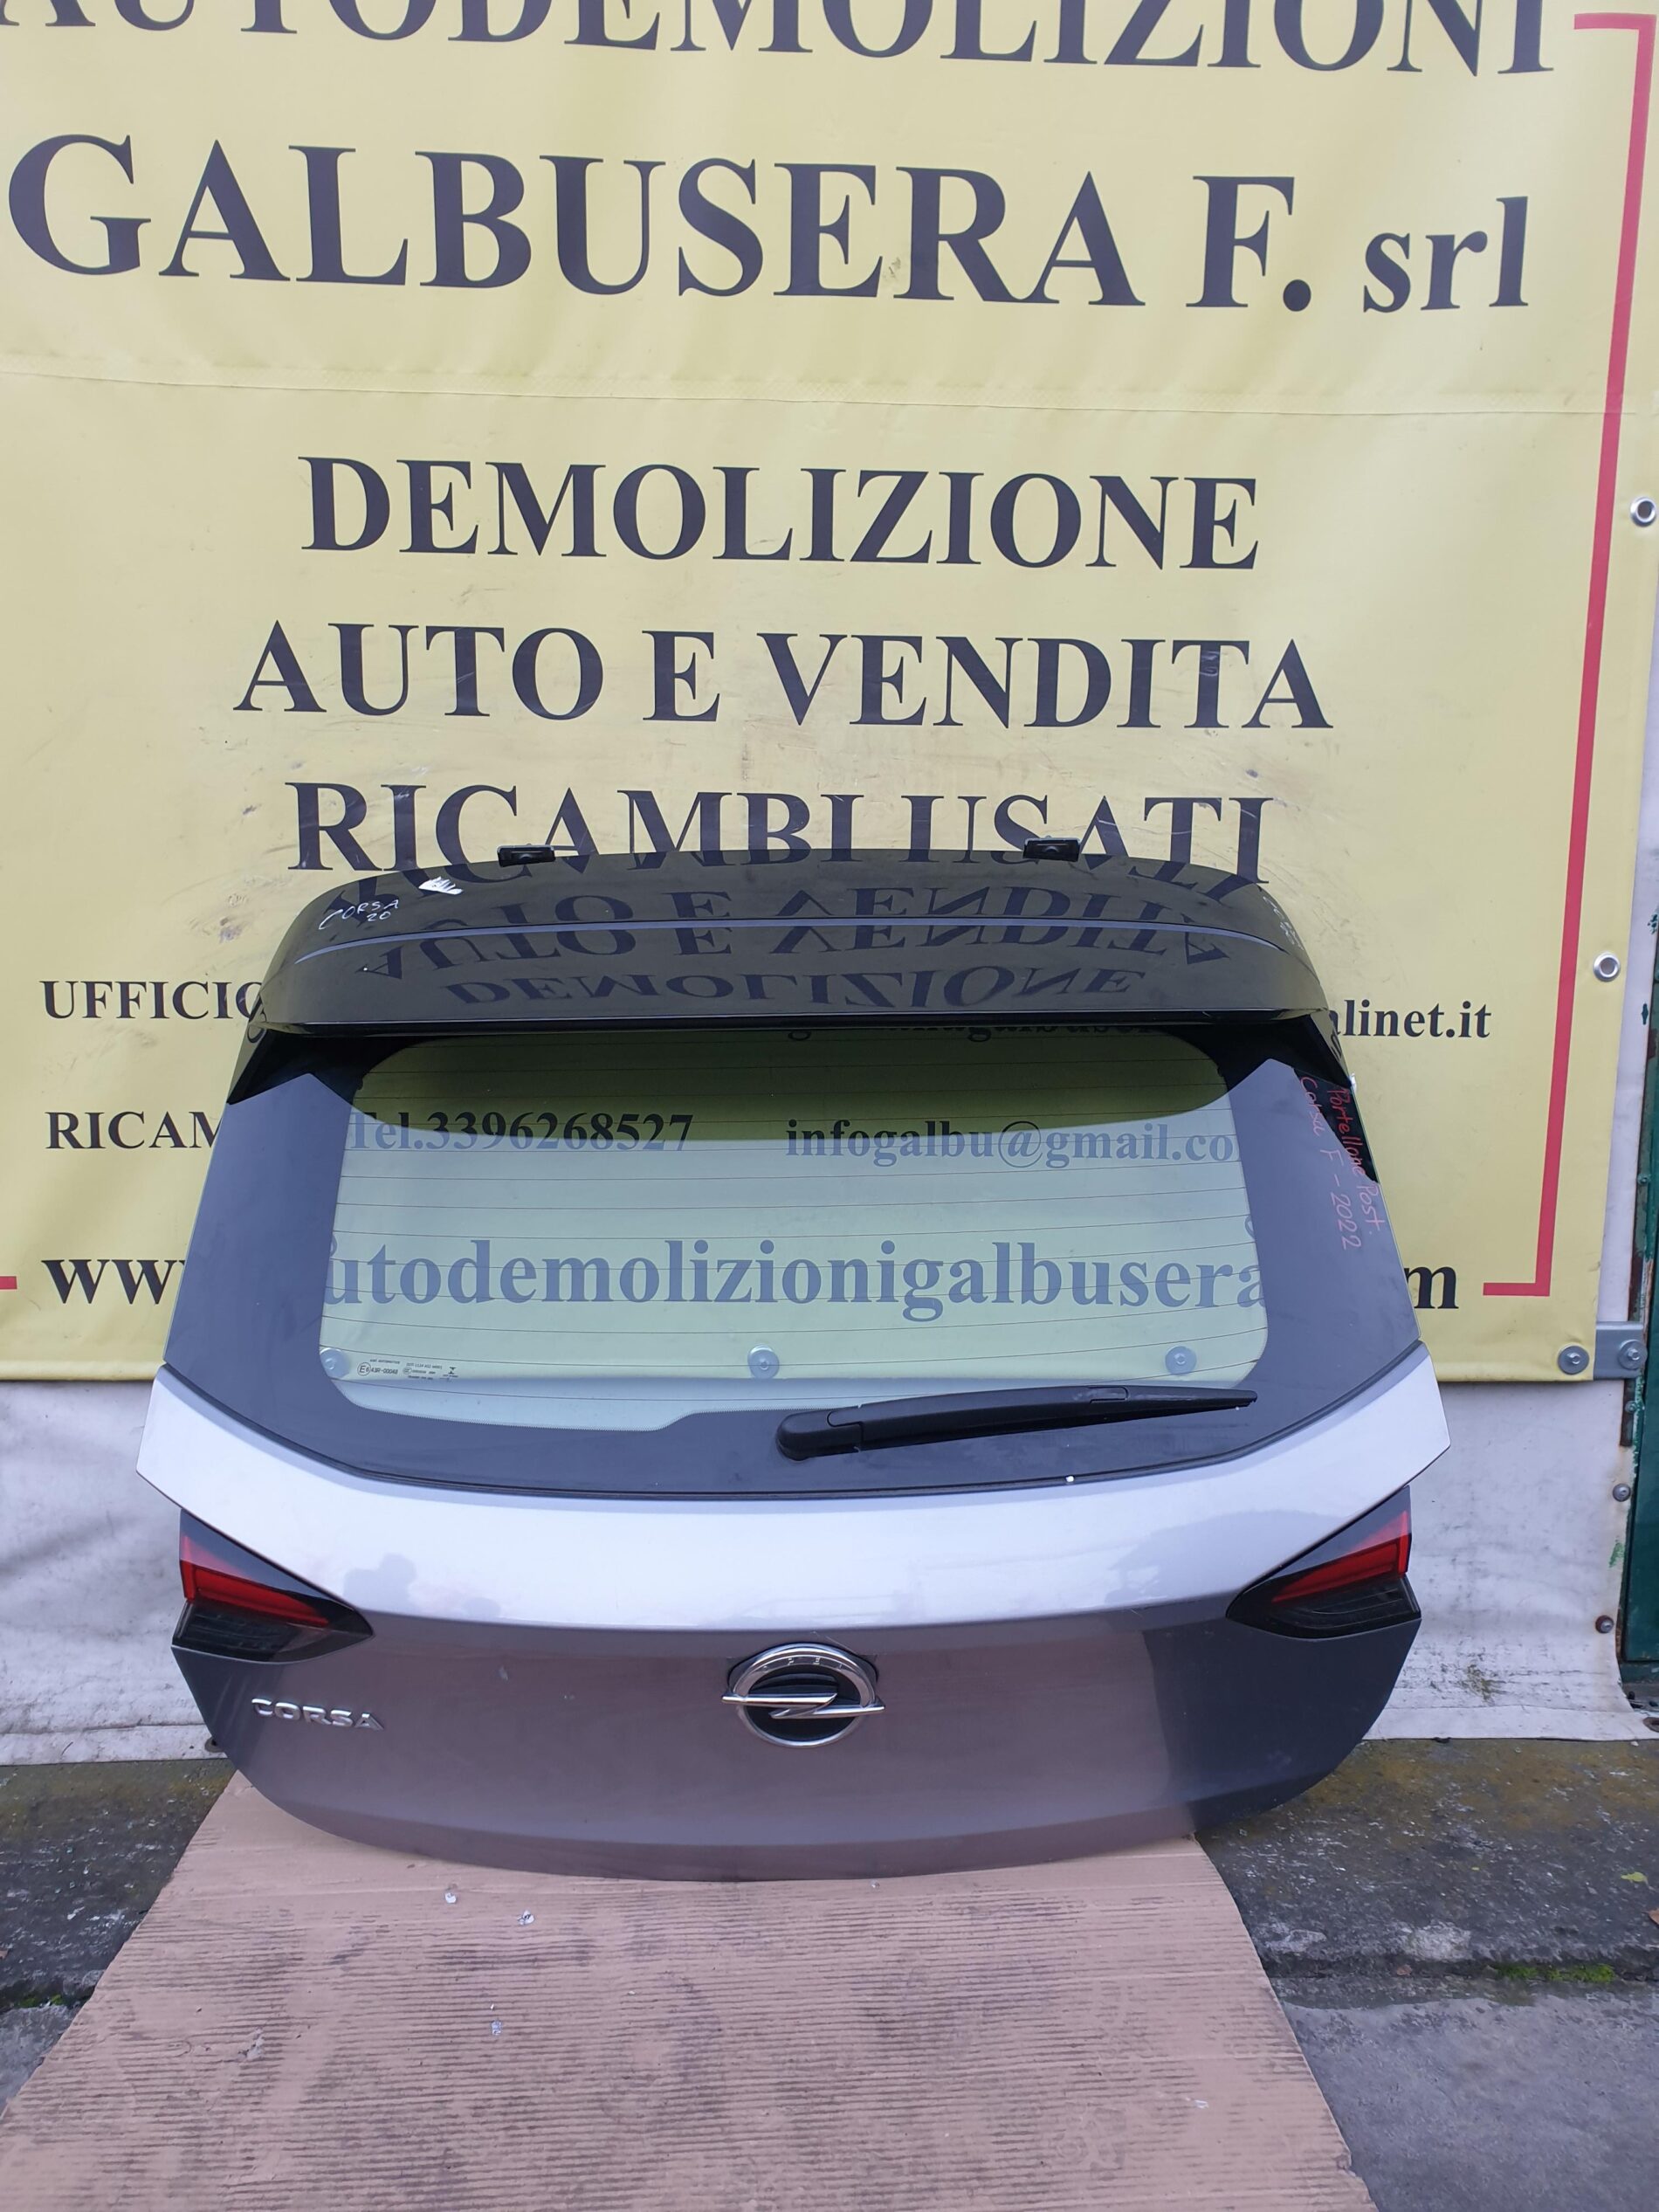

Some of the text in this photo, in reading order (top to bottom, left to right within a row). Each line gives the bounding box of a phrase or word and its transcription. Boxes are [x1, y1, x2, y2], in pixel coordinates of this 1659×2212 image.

[8, 134, 1530, 314] GALBUSERA F. srl
[298, 455, 1259, 571] DEMOLIZIONE
[232, 619, 1334, 729] AUTO E VENDITA
[285, 782, 1275, 884] RICAMBI USATI
[318, 899, 399, 930] CORSA
[350, 1111, 693, 1153] Tel.3396268527
[786, 1119, 1234, 1168] infogalbu@gmail.co
[1330, 1192, 1362, 1251] 2022
[41, 1258, 186, 1305] ww
[251, 1698, 385, 1731] CORSA
